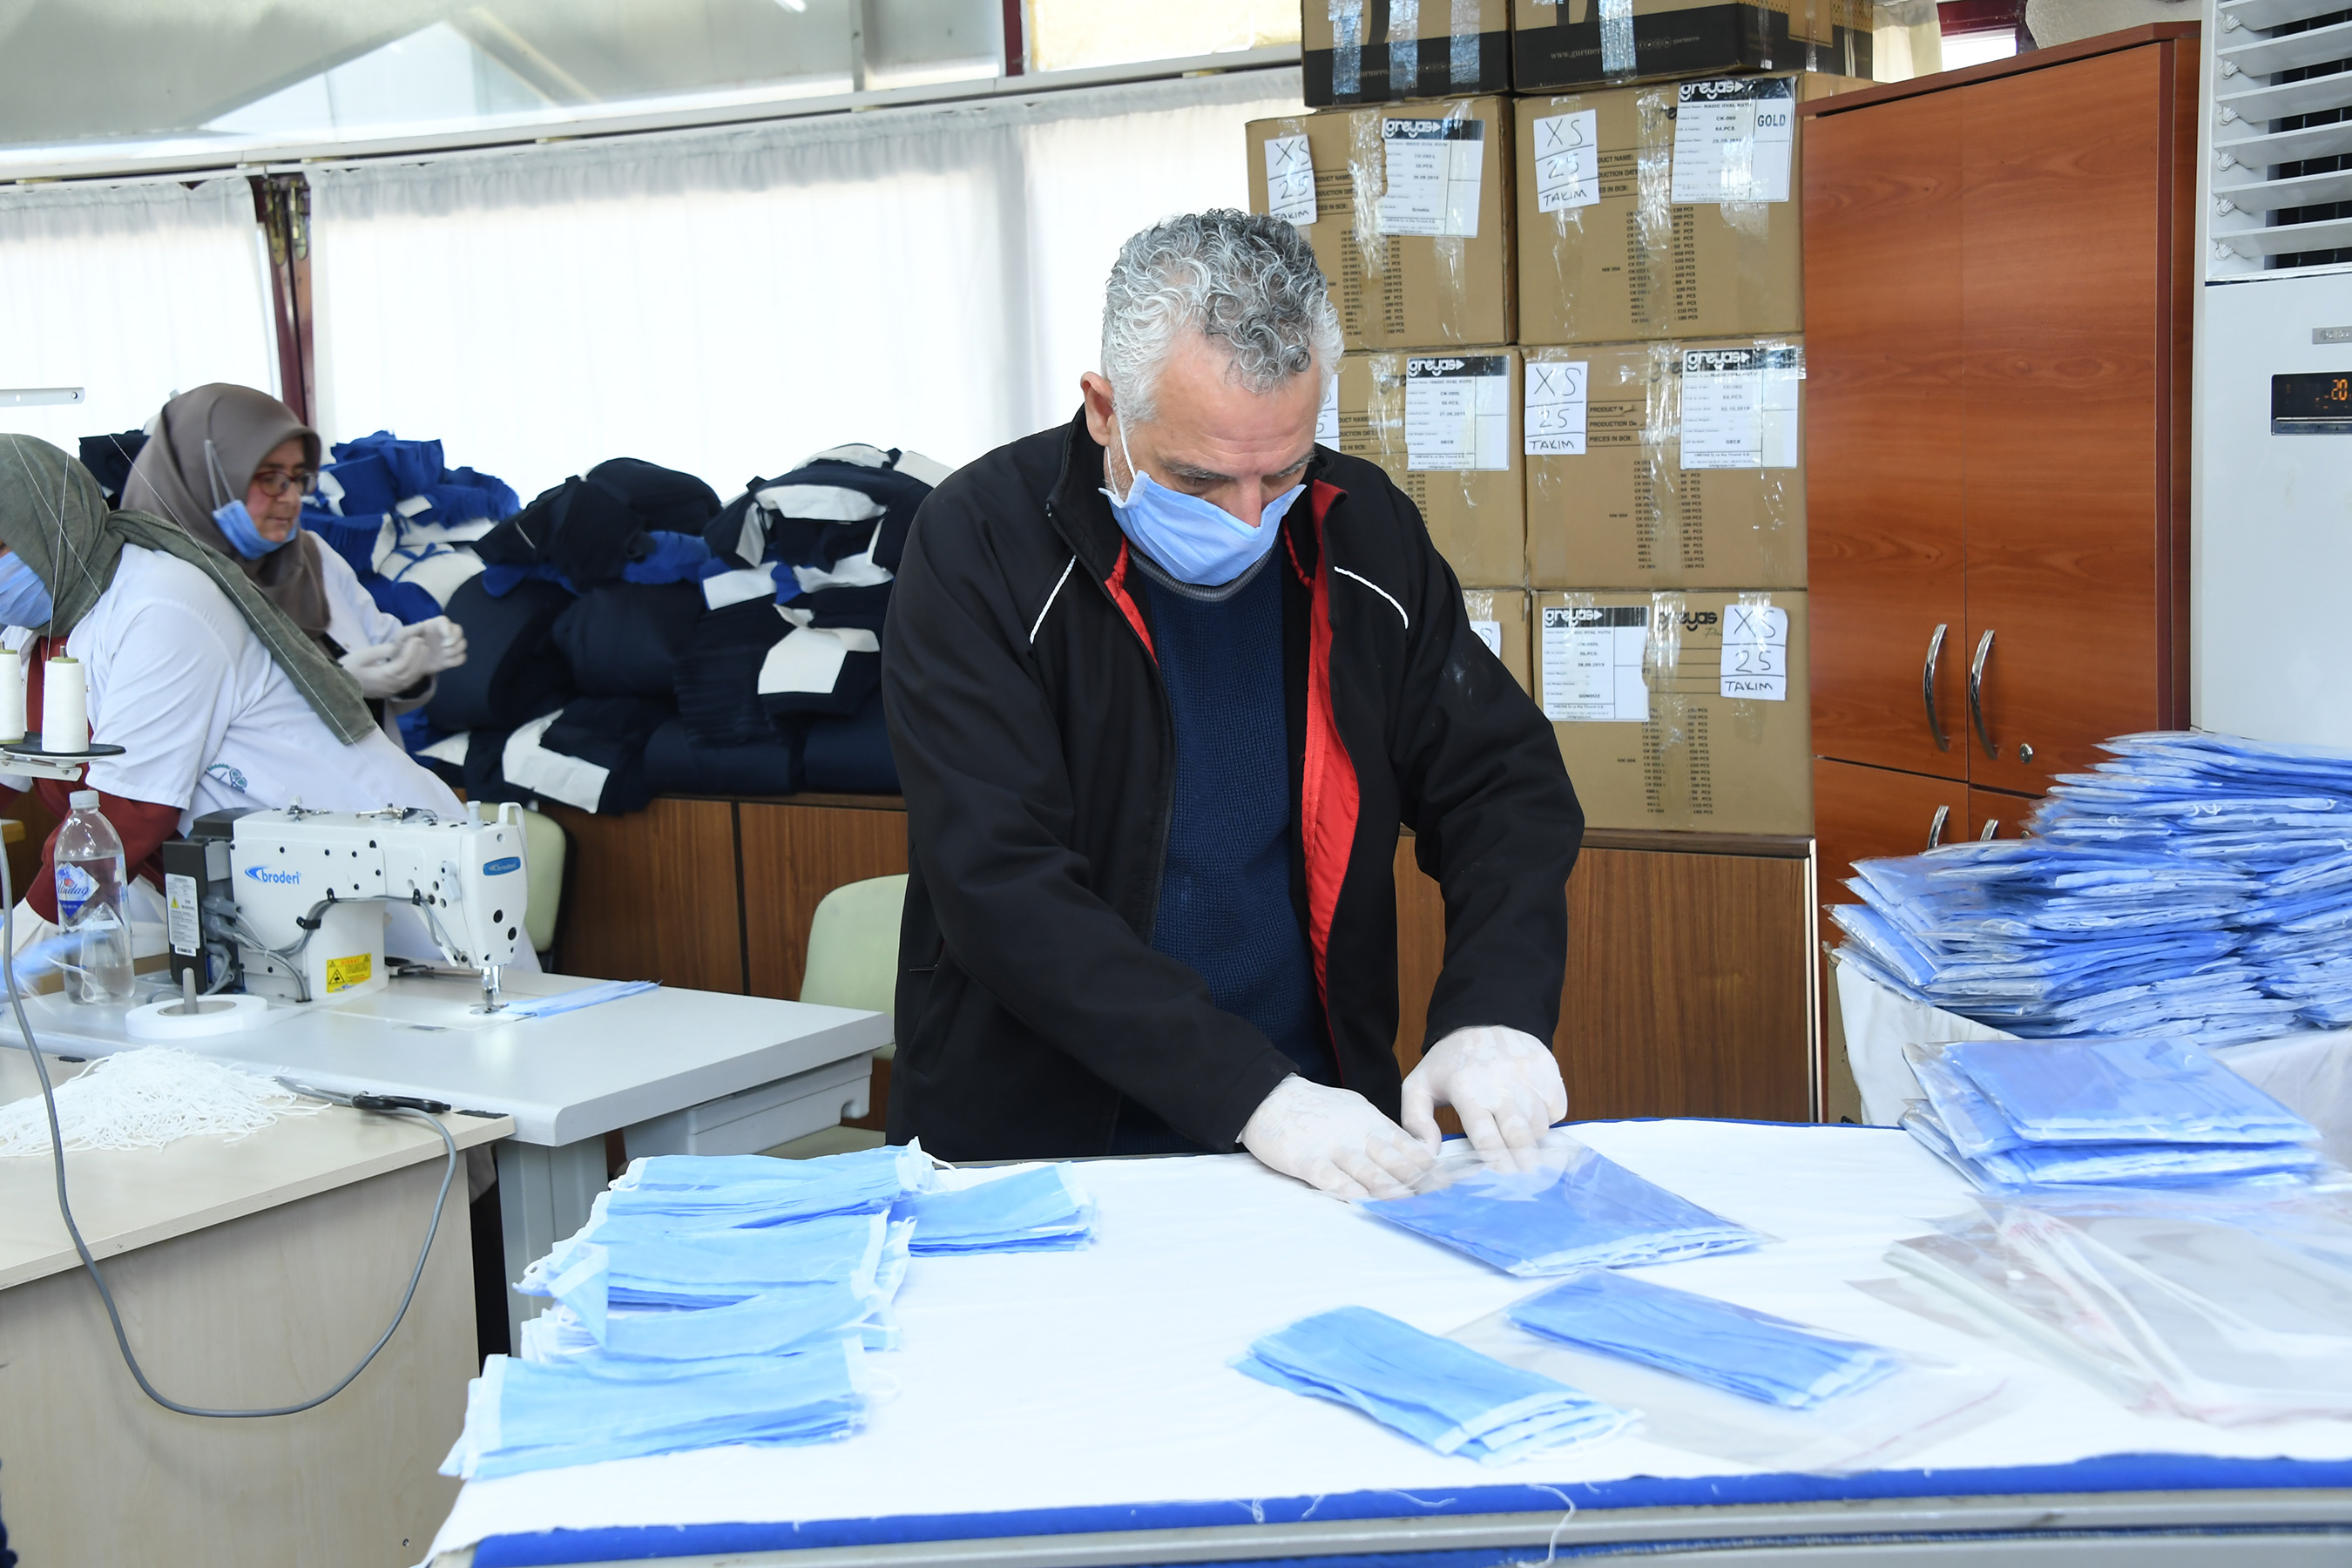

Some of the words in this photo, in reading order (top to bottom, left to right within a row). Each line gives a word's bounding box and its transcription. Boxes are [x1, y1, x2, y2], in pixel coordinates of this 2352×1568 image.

[1680, 82, 1734, 100] greyas
[1386, 121, 1432, 138] greyas
[1758, 114, 1786, 127] GOLD
[1546, 119, 1582, 147] XS
[1276, 140, 1309, 166] XS
[1547, 153, 1579, 179] 25
[1279, 176, 1308, 199] 25
[1543, 189, 1587, 206] TAKIM
[1274, 210, 1309, 219] TAKIM
[1408, 359, 1455, 377] greyas
[1688, 351, 1739, 371] greyas
[1534, 368, 1581, 397] XS
[2331, 379, 2348, 401] 20
[1539, 409, 1569, 428] 25
[1529, 440, 1574, 450] TAKIM
[1545, 609, 1593, 626] greyas
[1734, 609, 1775, 638] XS
[1735, 651, 1771, 673] 25
[1724, 681, 1773, 692] TAKIM
[262, 869, 299, 884] broderi
